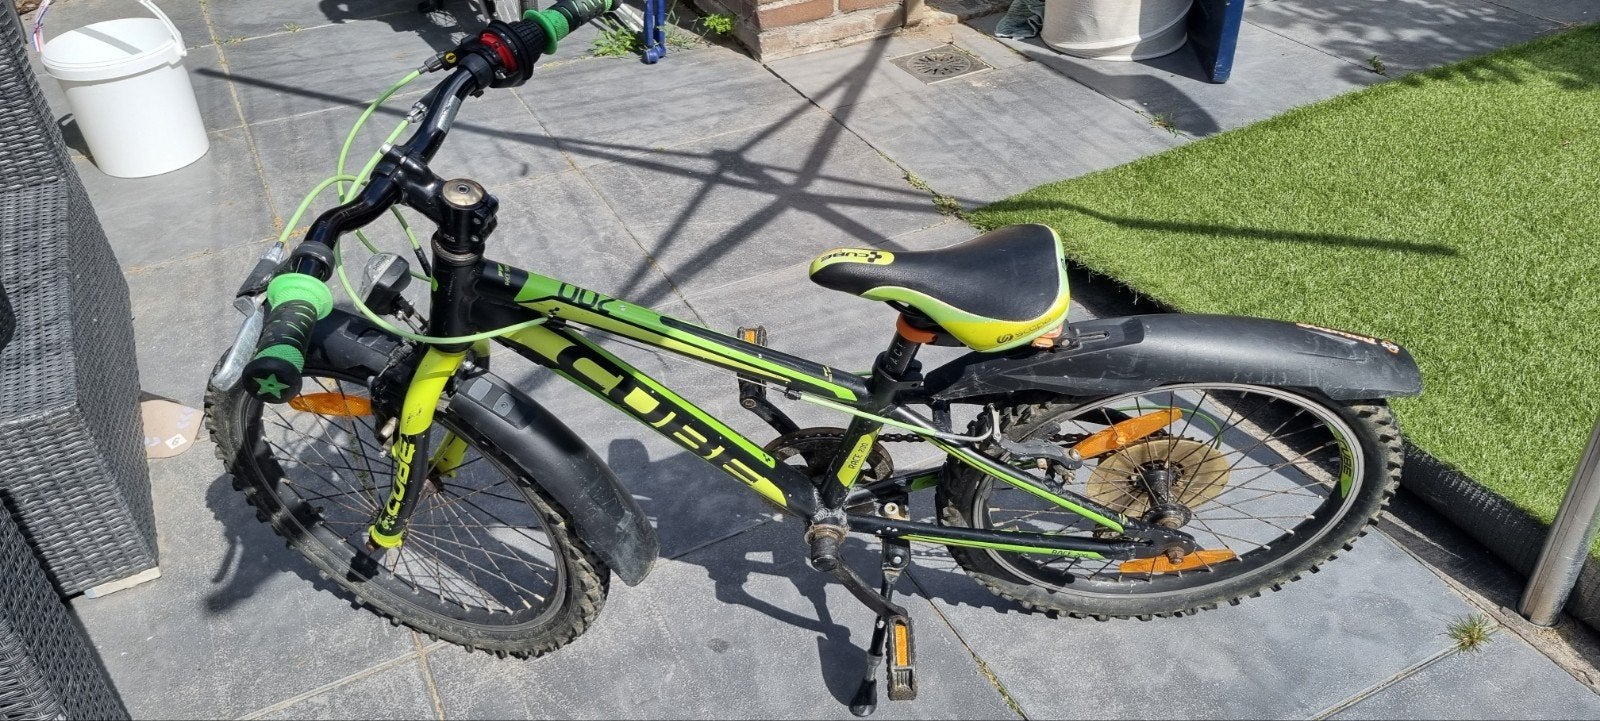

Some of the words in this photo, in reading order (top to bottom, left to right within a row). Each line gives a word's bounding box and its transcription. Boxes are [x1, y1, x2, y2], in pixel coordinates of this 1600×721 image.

[556, 345, 768, 490] CUBE
[386, 441, 415, 516] CUBE
[847, 453, 863, 470] RACE
